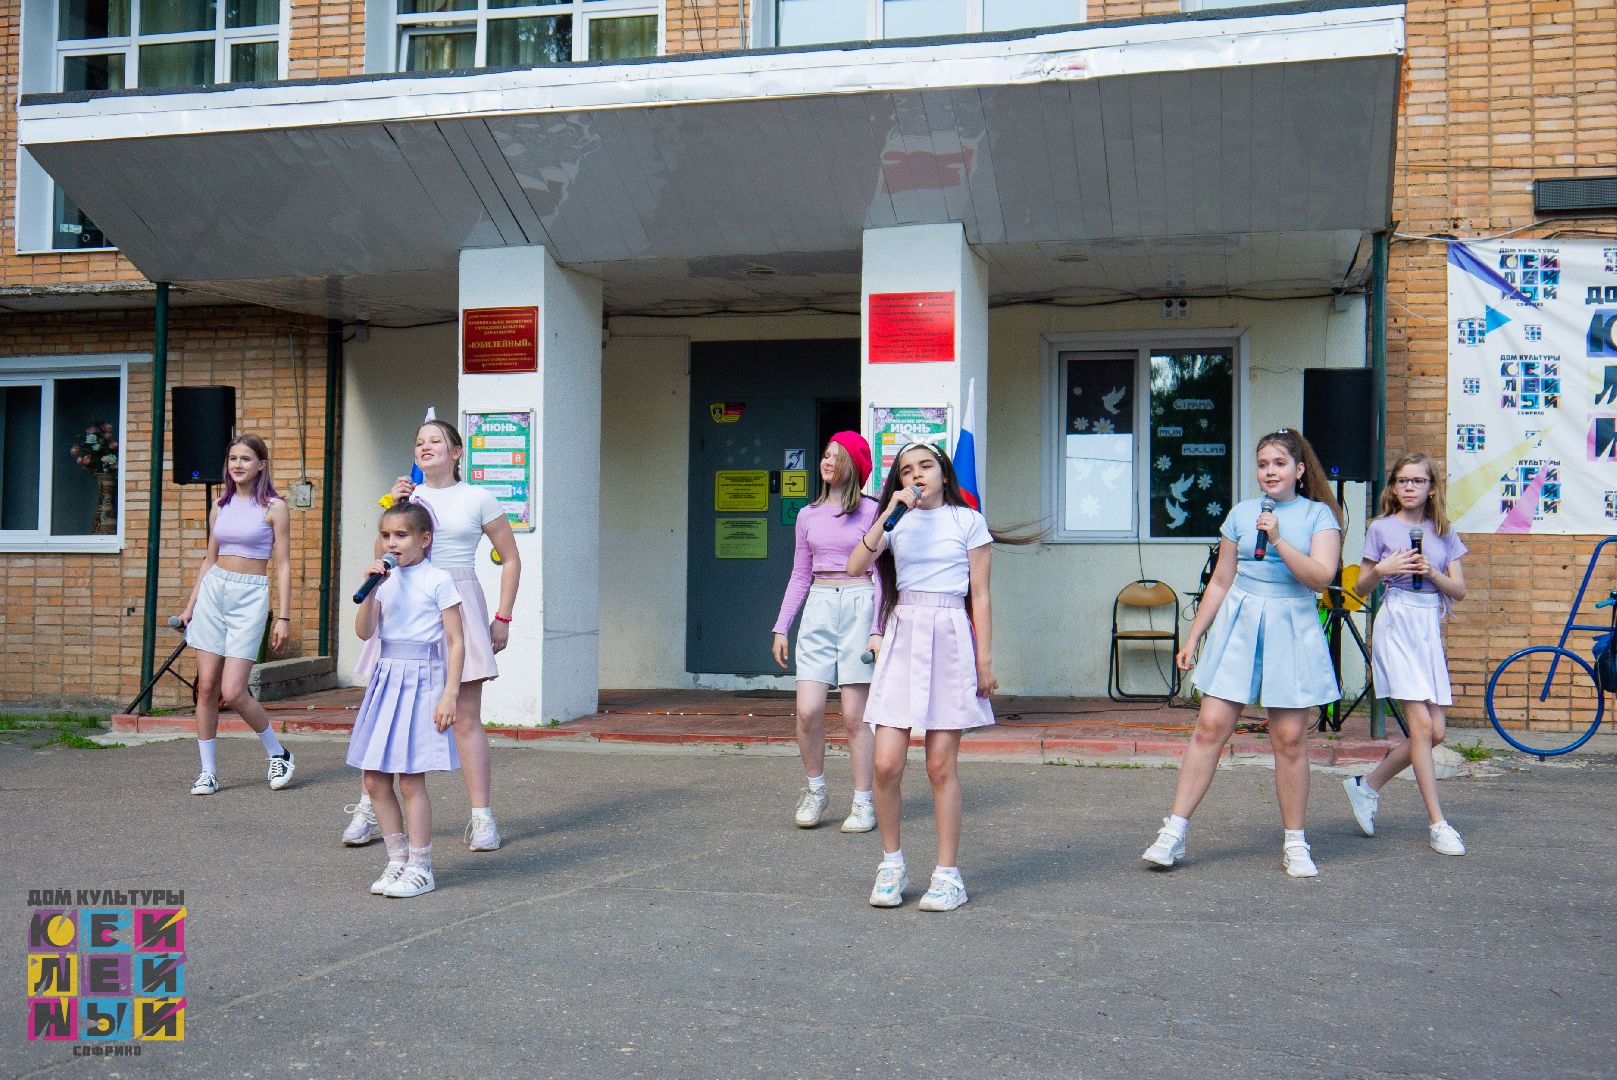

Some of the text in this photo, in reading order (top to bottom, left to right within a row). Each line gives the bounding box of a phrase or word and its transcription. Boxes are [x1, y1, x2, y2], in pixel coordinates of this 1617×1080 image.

[481, 423, 517, 432] ИЮНЬ
[890, 423, 931, 433] ИЮНЬ
[476, 437, 482, 447] 5
[515, 453, 521, 463] 8
